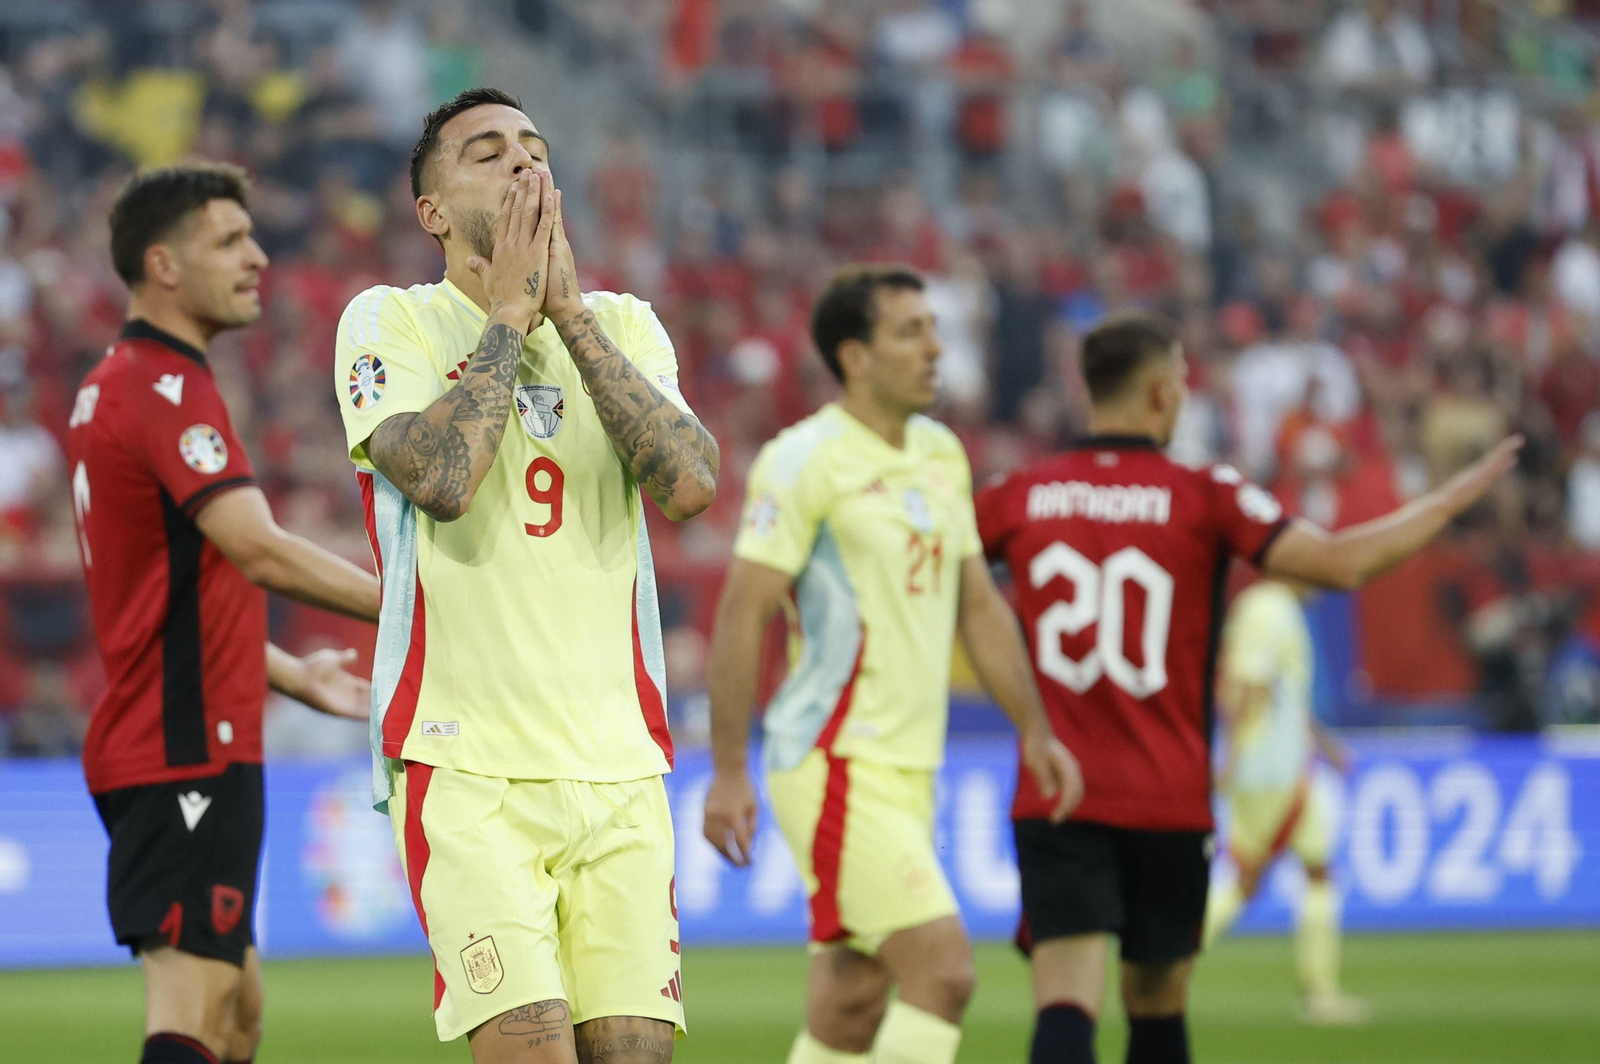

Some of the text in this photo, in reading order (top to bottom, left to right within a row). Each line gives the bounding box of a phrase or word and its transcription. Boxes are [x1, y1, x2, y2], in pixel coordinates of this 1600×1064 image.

[524, 270, 540, 299] Leo
[525, 456, 565, 537] 9
[905, 531, 943, 597] 21
[1029, 540, 1175, 698] 20
[1268, 760, 1584, 904] 024
